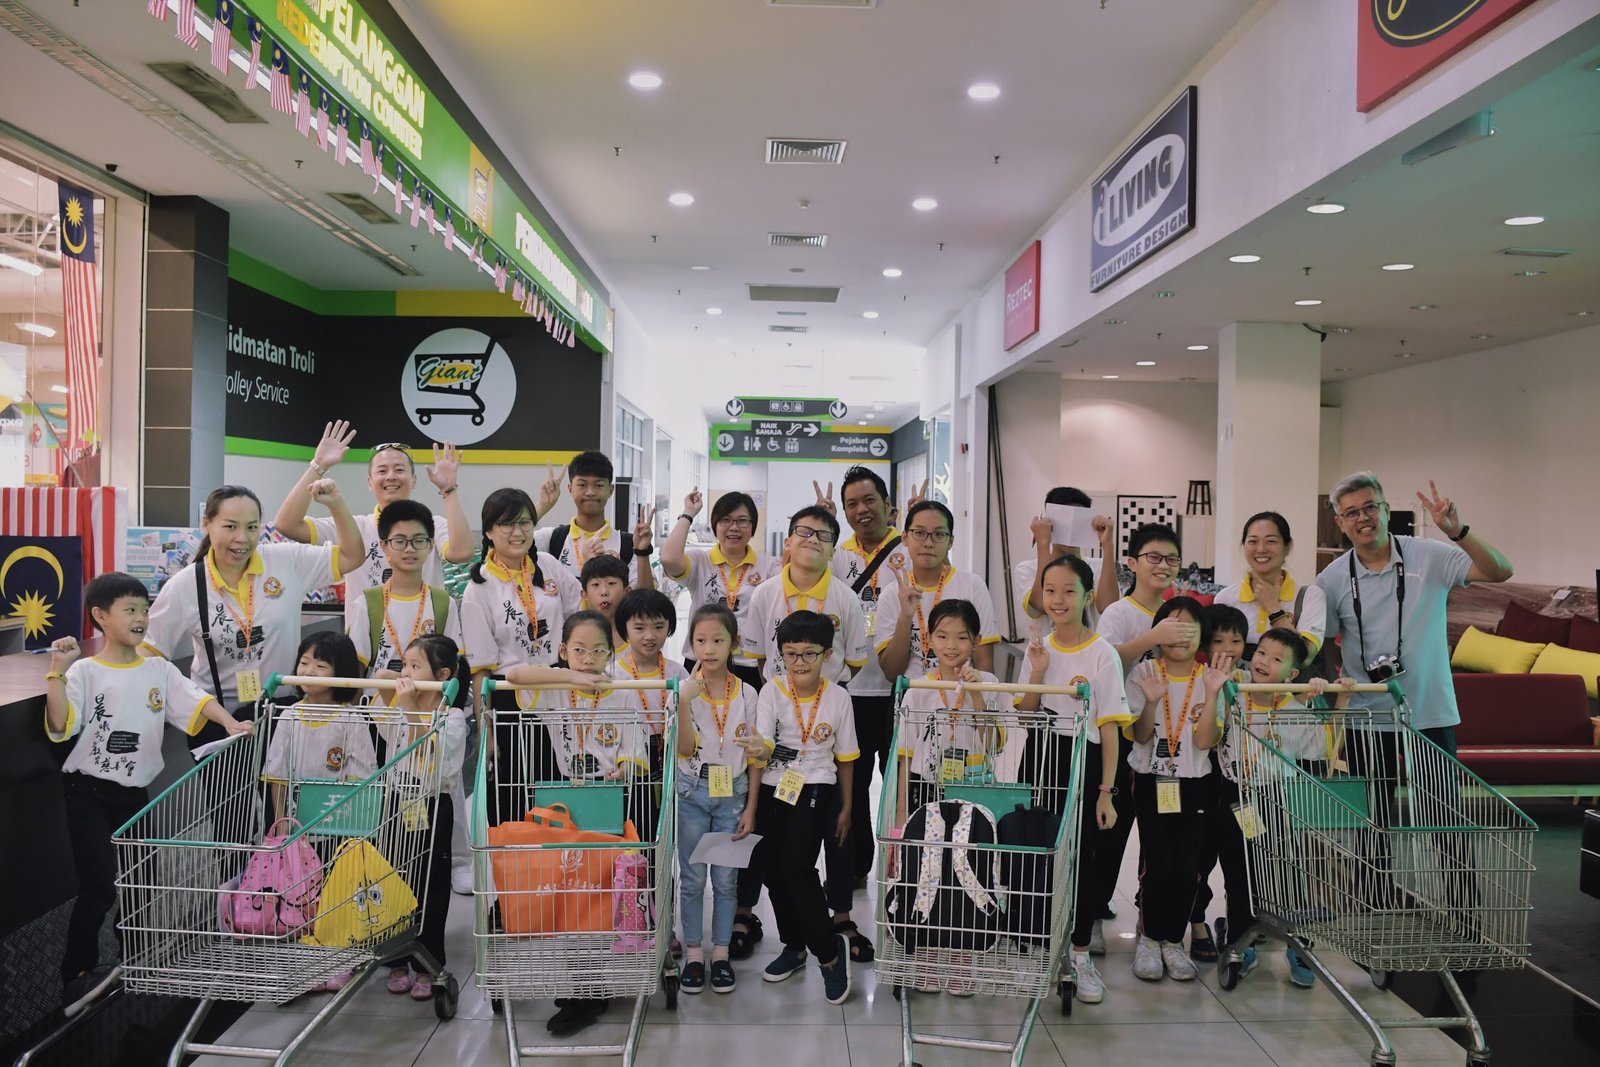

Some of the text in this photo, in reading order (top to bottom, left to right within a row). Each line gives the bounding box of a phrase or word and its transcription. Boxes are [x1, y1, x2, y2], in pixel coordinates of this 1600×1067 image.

[277, 0, 423, 160] REDEMPTION COUNTER
[320, 0, 425, 129] PELANGGAN
[1109, 144, 1174, 233] LIVING
[1090, 208, 1187, 287] FURNITURE DESIGN
[226, 324, 315, 375] idmatan Troli
[254, 376, 290, 405] Service
[417, 357, 483, 389] Giant
[755, 428, 783, 436] SAHAJA
[831, 445, 868, 454] Kompleks
[840, 437, 868, 446] Pejabat
